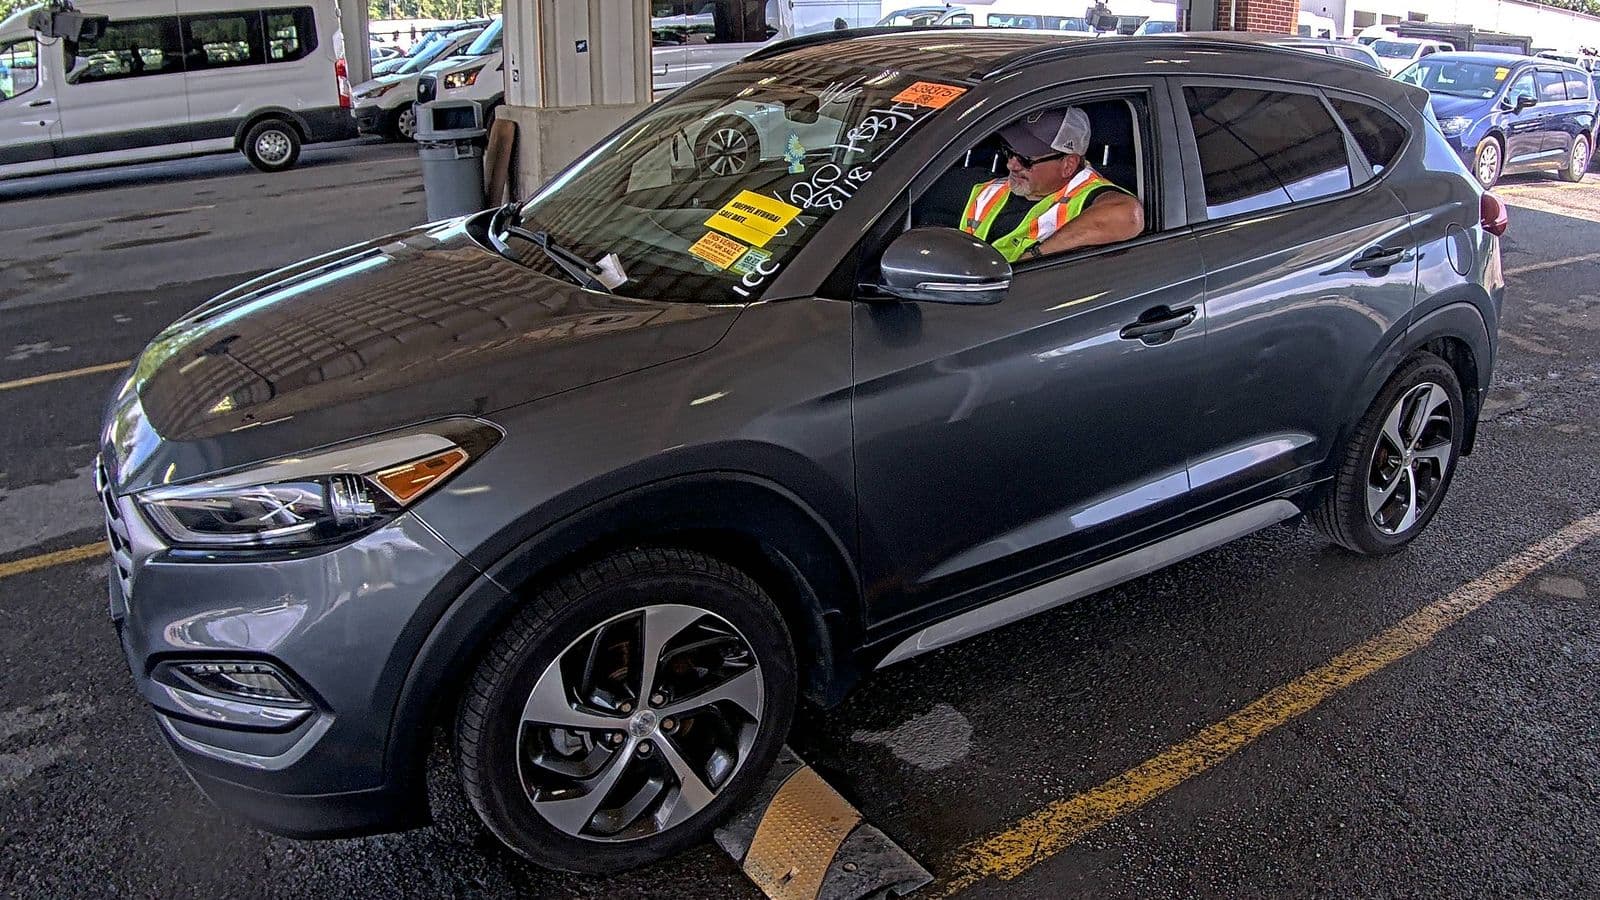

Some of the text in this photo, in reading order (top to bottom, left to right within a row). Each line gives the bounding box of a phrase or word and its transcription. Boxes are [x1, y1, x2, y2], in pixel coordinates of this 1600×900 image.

[718, 210, 747, 224] SALE DATE
[753, 208, 781, 223] HYUNDAI
[718, 235, 744, 252] VEHICLE
[721, 246, 737, 256] SALE
